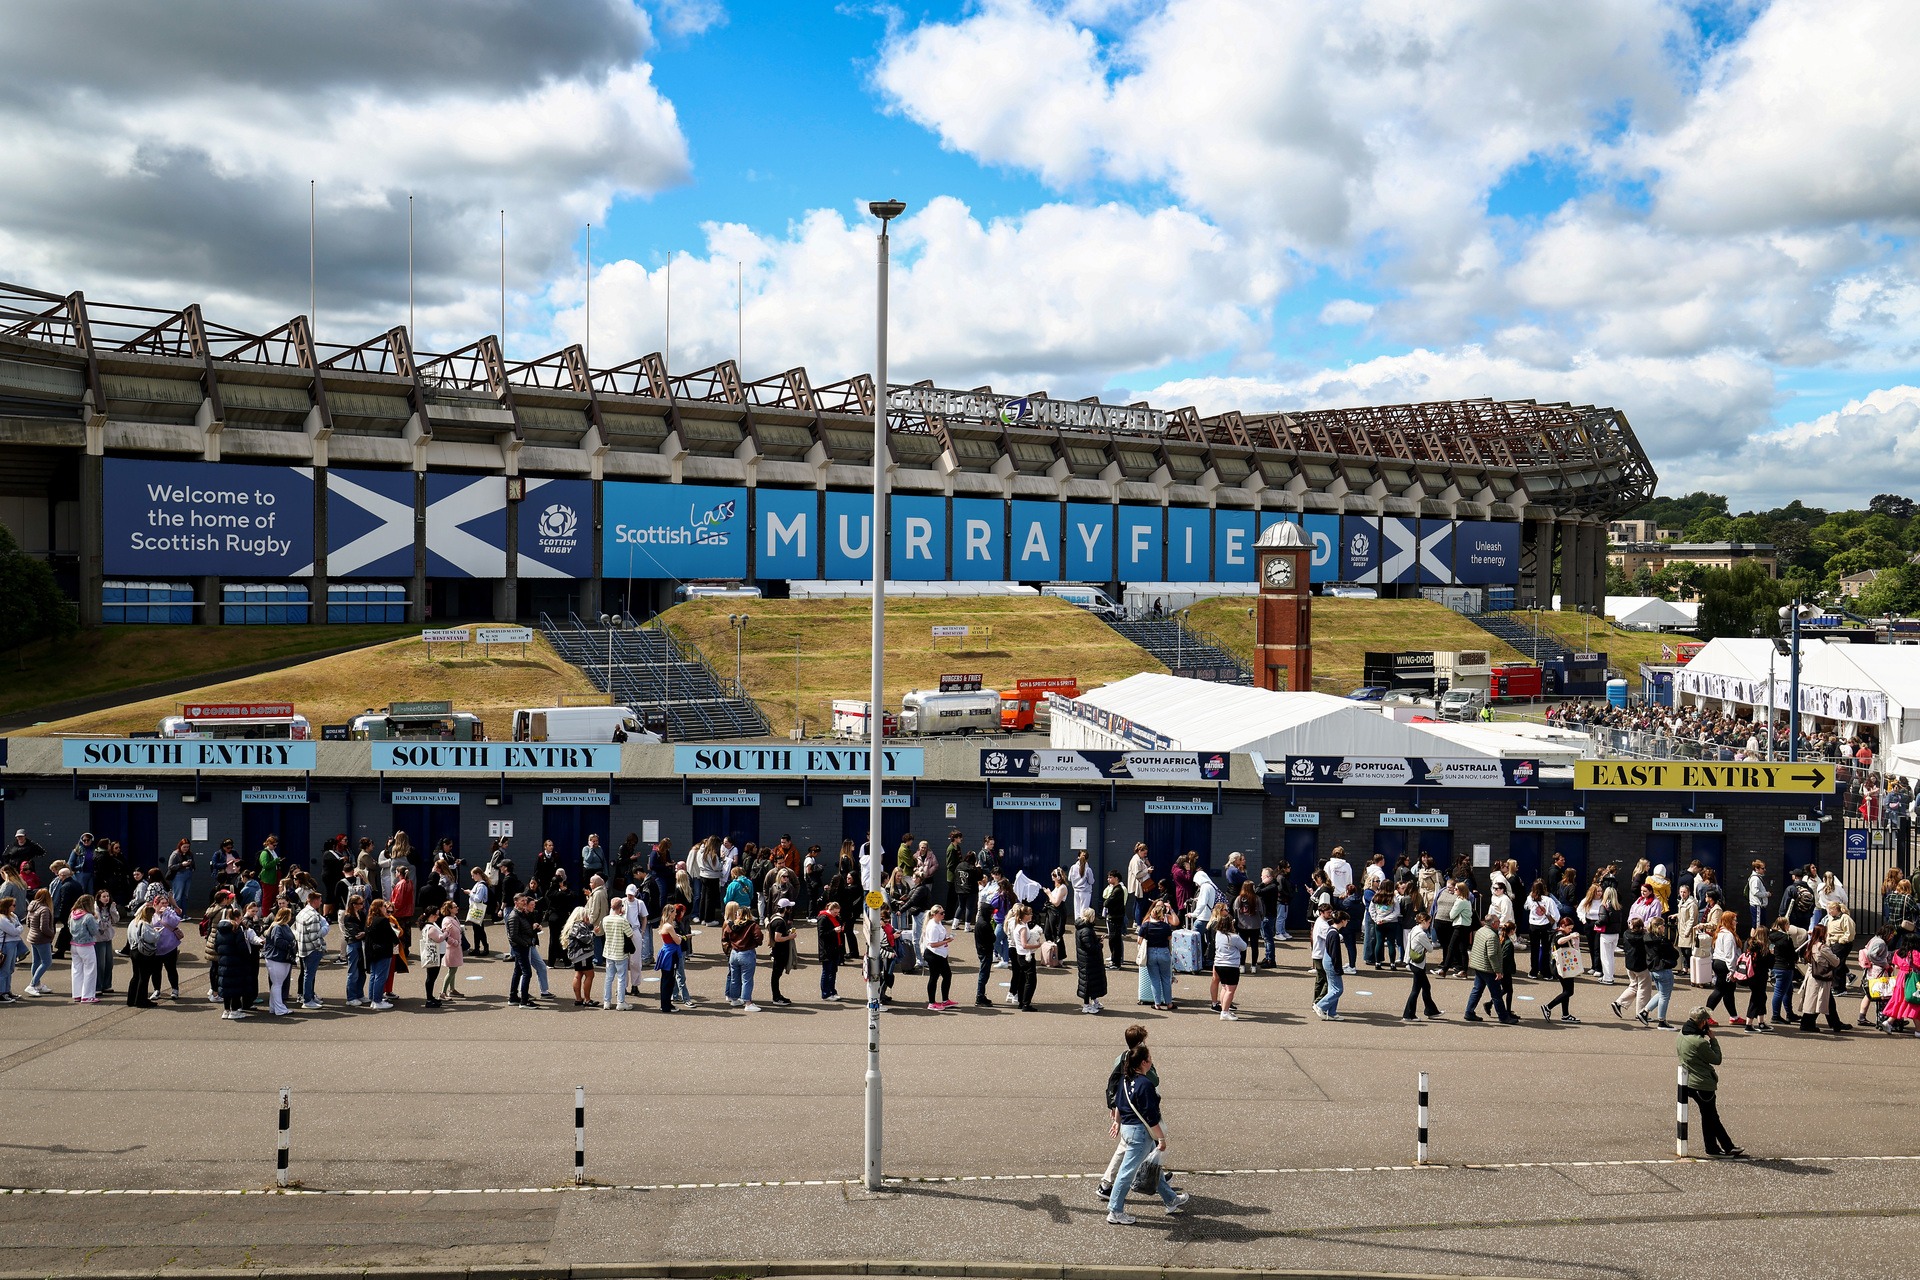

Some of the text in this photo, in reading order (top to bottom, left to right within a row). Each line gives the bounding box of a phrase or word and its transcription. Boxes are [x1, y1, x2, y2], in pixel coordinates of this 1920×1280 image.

[962, 395, 997, 417] Gas
[1032, 401, 1168, 432] MURRAYFIELD
[148, 484, 276, 506] Welcome to
[148, 509, 276, 529] the home of
[690, 500, 735, 528] Lass
[130, 532, 292, 556] Scottish Rugby
[538, 538, 577, 546] SCOTTISH
[615, 524, 728, 546] Scottish Gas
[767, 512, 1331, 566] MURRAYFIED
[1475, 540, 1502, 552] Unleash
[1470, 554, 1506, 566] the energy
[1396, 655, 1434, 665] WING-DROP
[202, 707, 240, 715] COFFEE
[250, 706, 292, 714] DONUTS
[84, 744, 293, 764] SOUTH ENTRY
[392, 746, 598, 768] SOUTH ENTRY
[695, 749, 792, 770] SOUTH
[1592, 765, 1781, 788] EAST ENTRY
